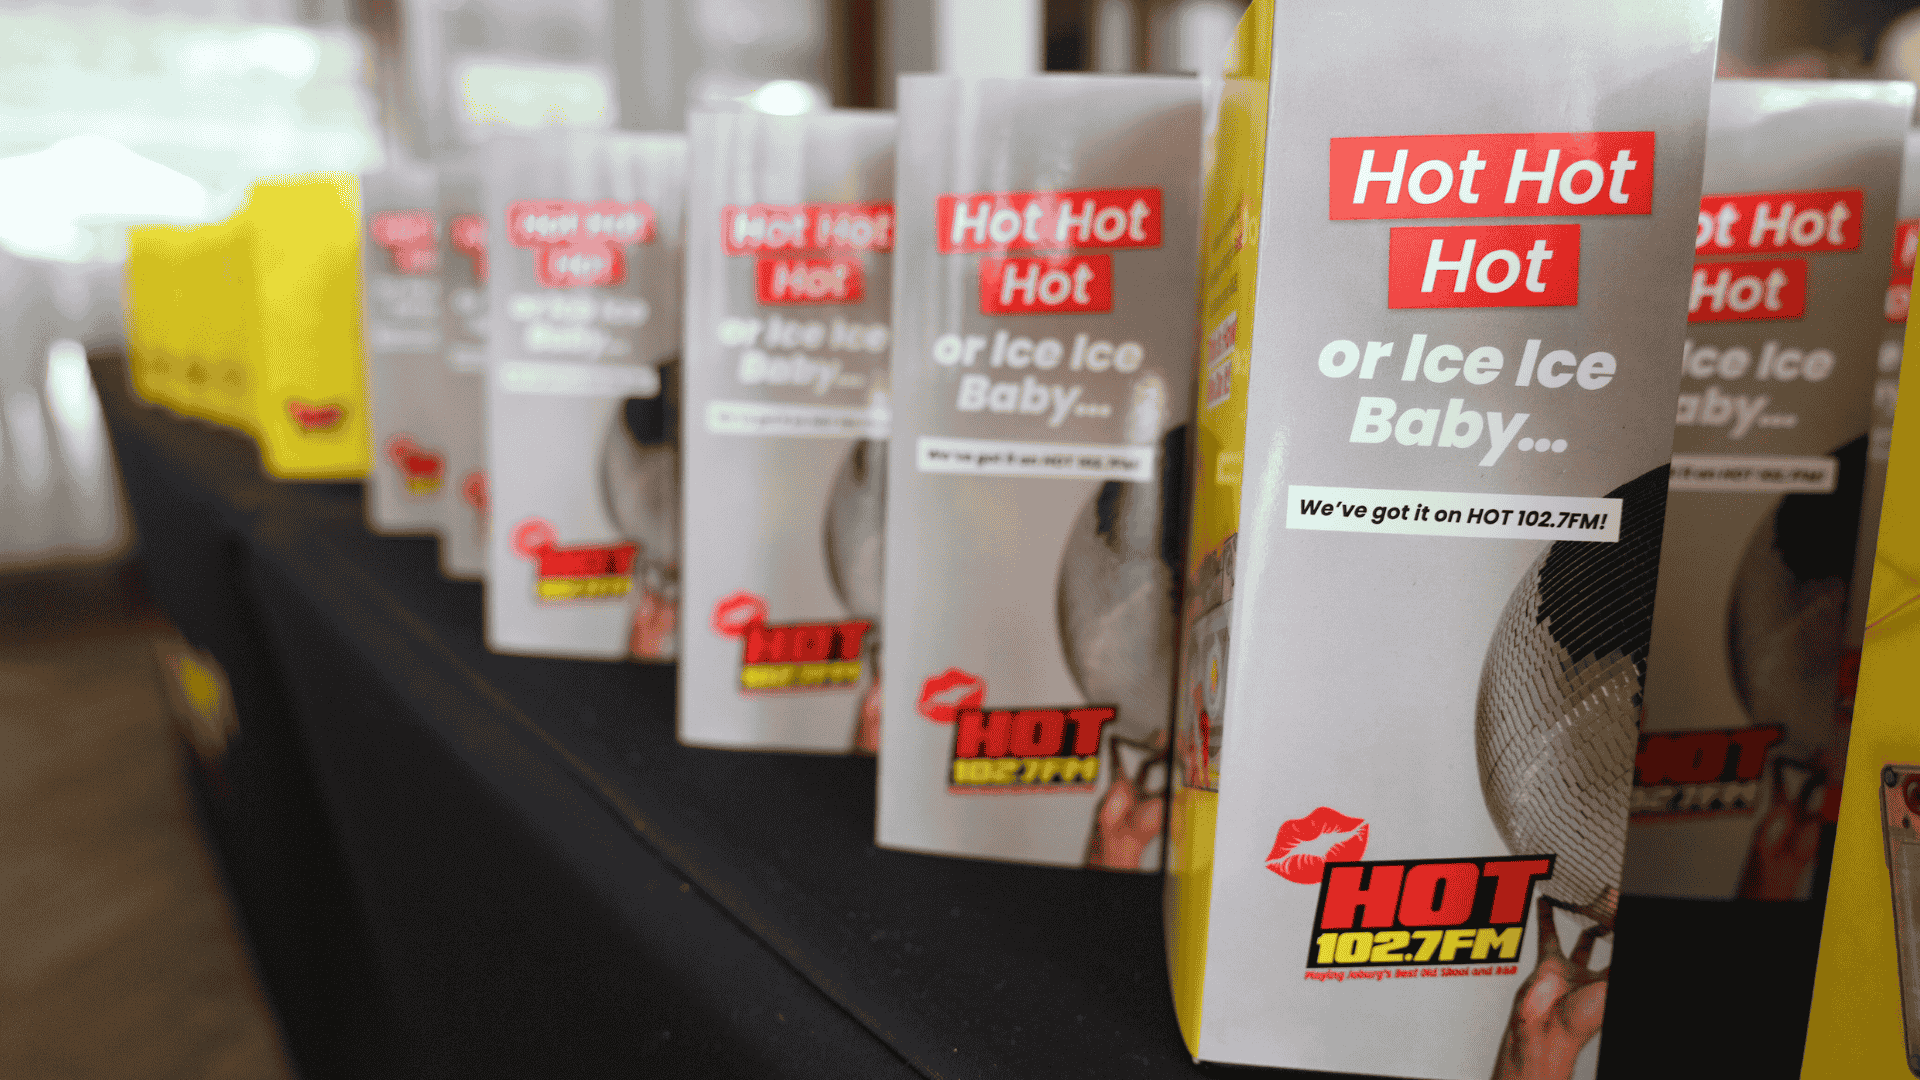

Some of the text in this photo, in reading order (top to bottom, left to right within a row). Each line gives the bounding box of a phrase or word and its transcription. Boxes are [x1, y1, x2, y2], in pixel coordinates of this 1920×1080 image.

[1352, 149, 1638, 205] Hot Hot
[734, 212, 805, 248] Hot
[952, 199, 1151, 244] Hot Hot
[1695, 202, 1740, 248] ot
[1750, 201, 1852, 246] Hot
[773, 262, 847, 297] Hot
[1001, 262, 1095, 305] Hot
[1420, 238, 1554, 293] Hot
[933, 328, 1144, 373] or Ice Ice
[1318, 333, 1617, 391] or Ice Ice
[1756, 339, 1836, 382] Ice
[1349, 396, 1567, 467] Baby...
[1299, 498, 1607, 530] We've got it on HOT 102.7FM!
[955, 707, 1116, 758] HOT
[1320, 859, 1549, 930] HOT
[1316, 926, 1523, 964] 102.7FM
